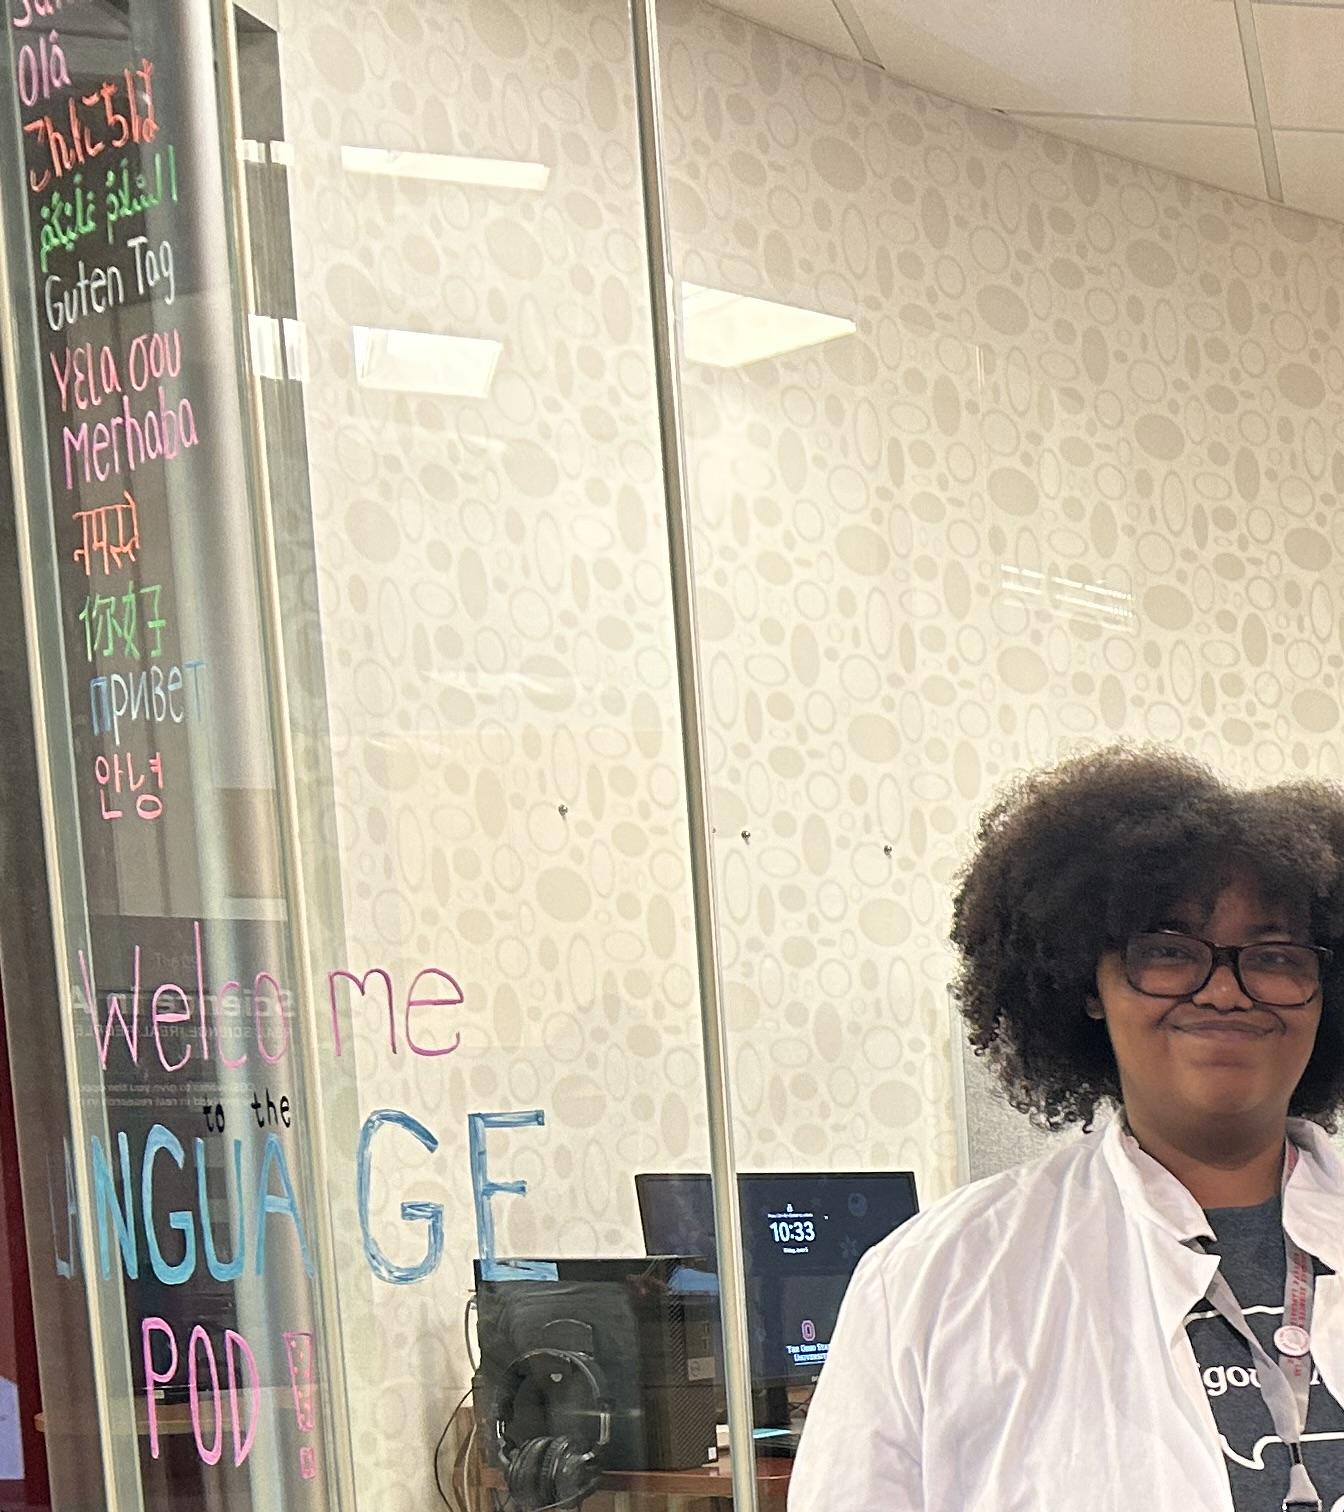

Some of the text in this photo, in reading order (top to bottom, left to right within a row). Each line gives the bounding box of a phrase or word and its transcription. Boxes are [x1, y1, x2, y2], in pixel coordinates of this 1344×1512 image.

[44, 235, 176, 332] Guten Tag
[62, 385, 199, 490] Merhaba
[72, 489, 140, 576] नमस्ते
[78, 580, 167, 663] 你好
[89, 659, 207, 747] Привет
[95, 752, 164, 820] 안녕
[203, 1088, 292, 1133] to the
[769, 1221, 816, 1243] 10:33
